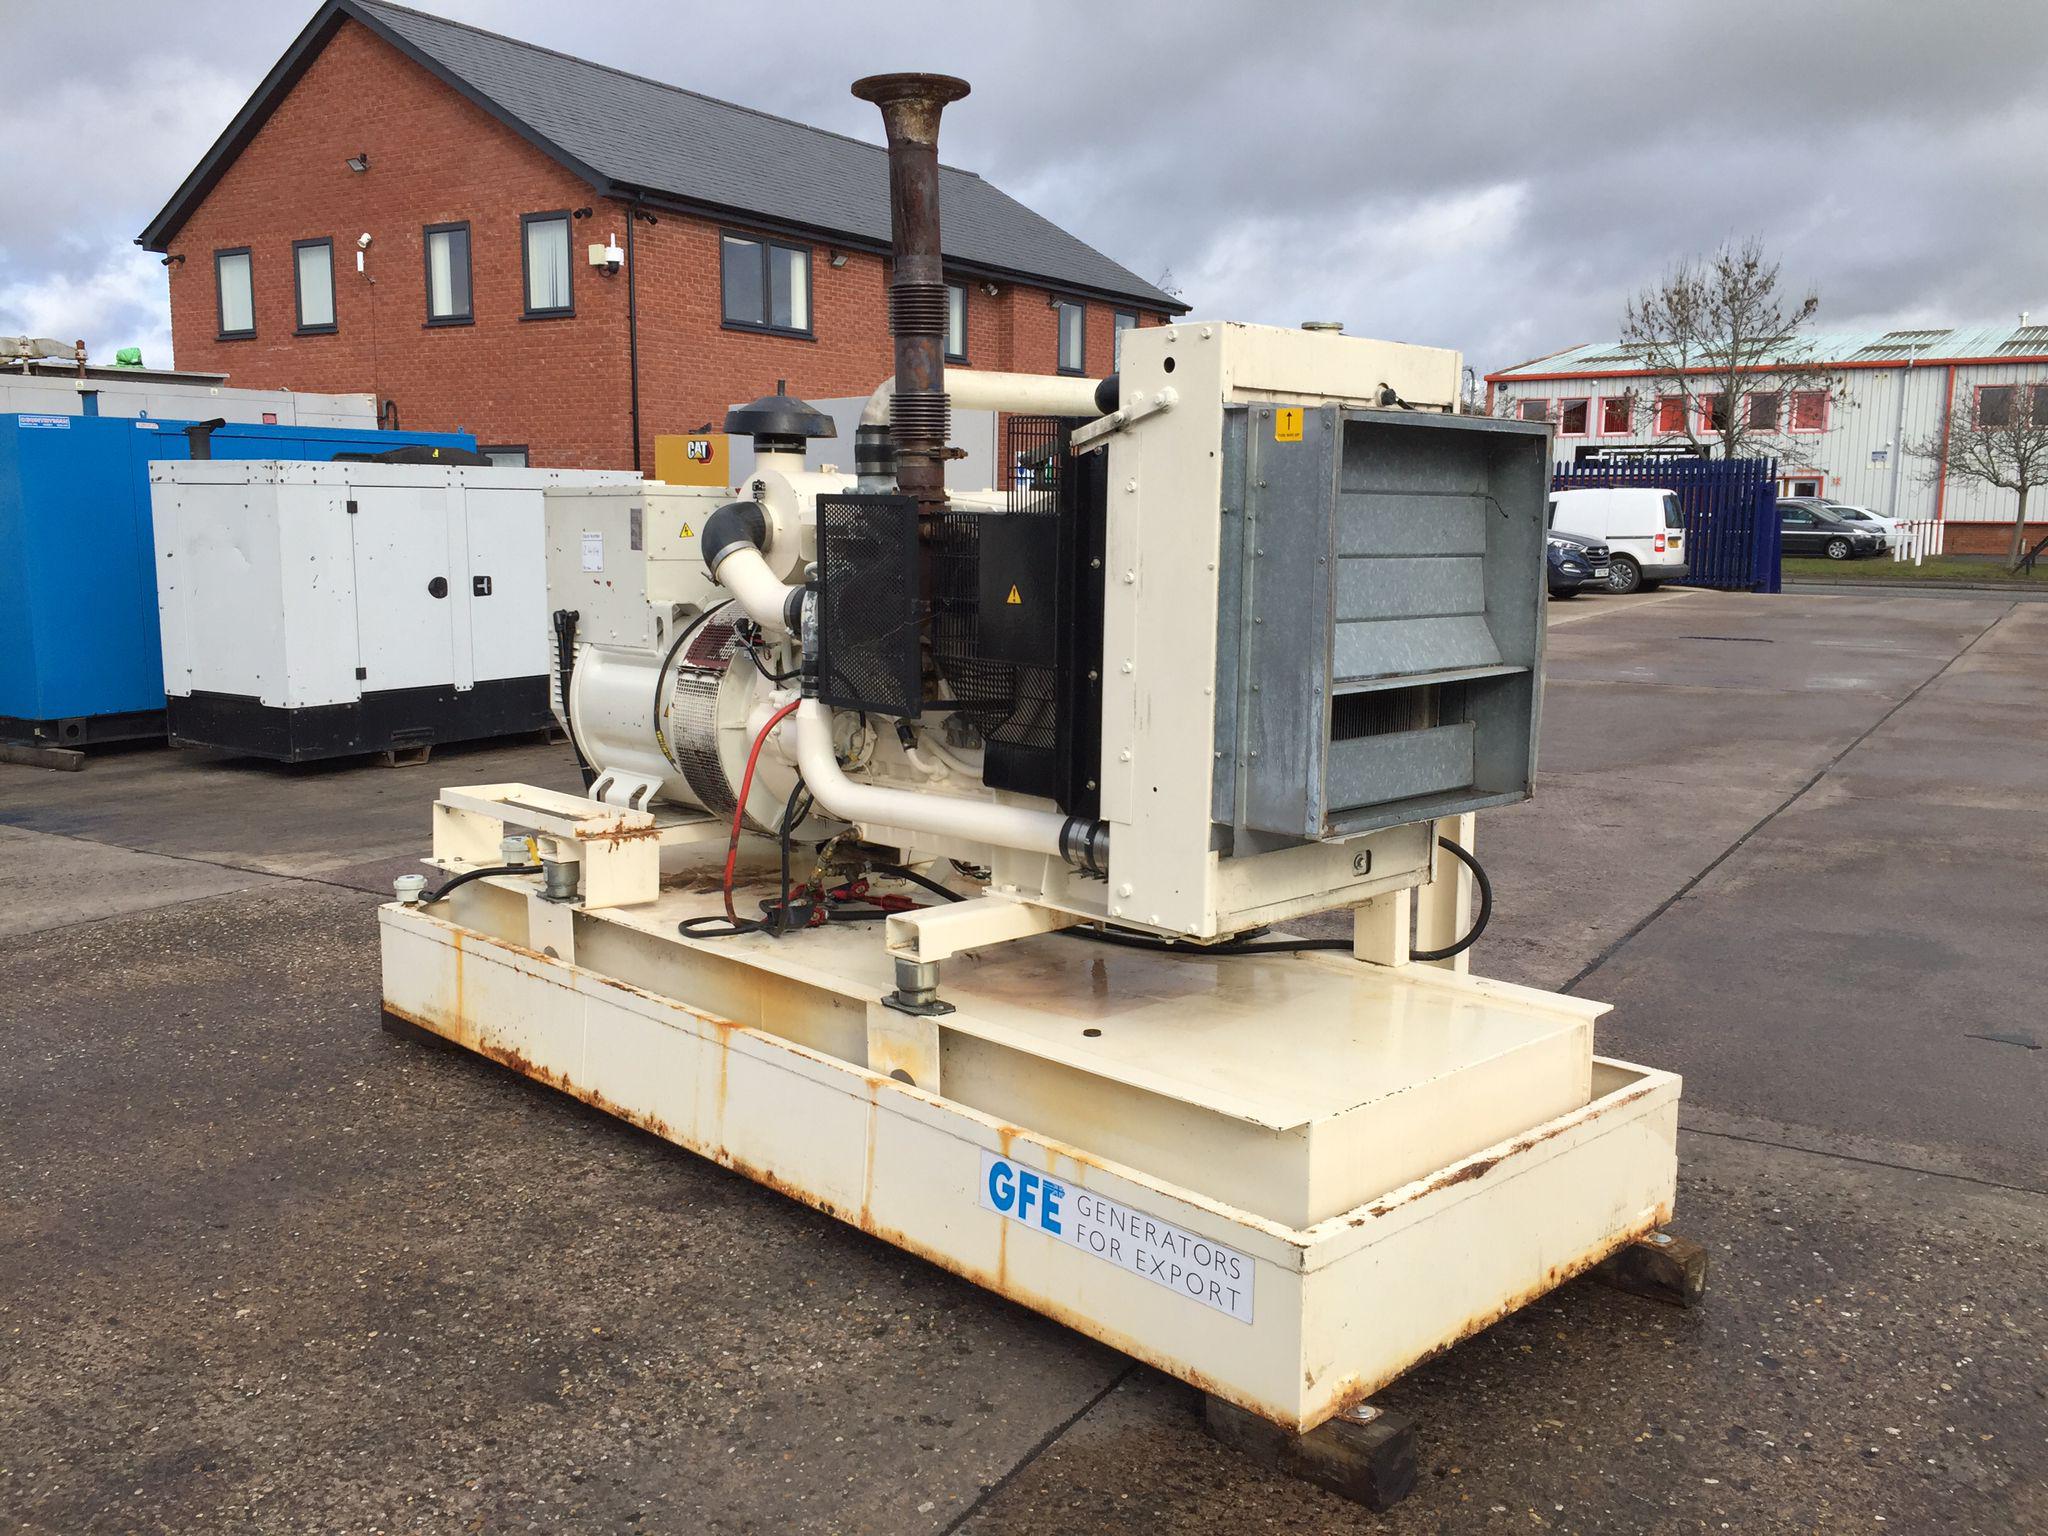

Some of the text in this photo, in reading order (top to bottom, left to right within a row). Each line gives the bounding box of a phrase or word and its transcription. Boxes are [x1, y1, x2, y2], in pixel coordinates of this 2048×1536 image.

[687, 441, 708, 459] CAT
[988, 1161, 1064, 1236] GFE
[1077, 1195, 1241, 1281] GENERATORS
[1076, 1223, 1241, 1312] FOR EXPORT
